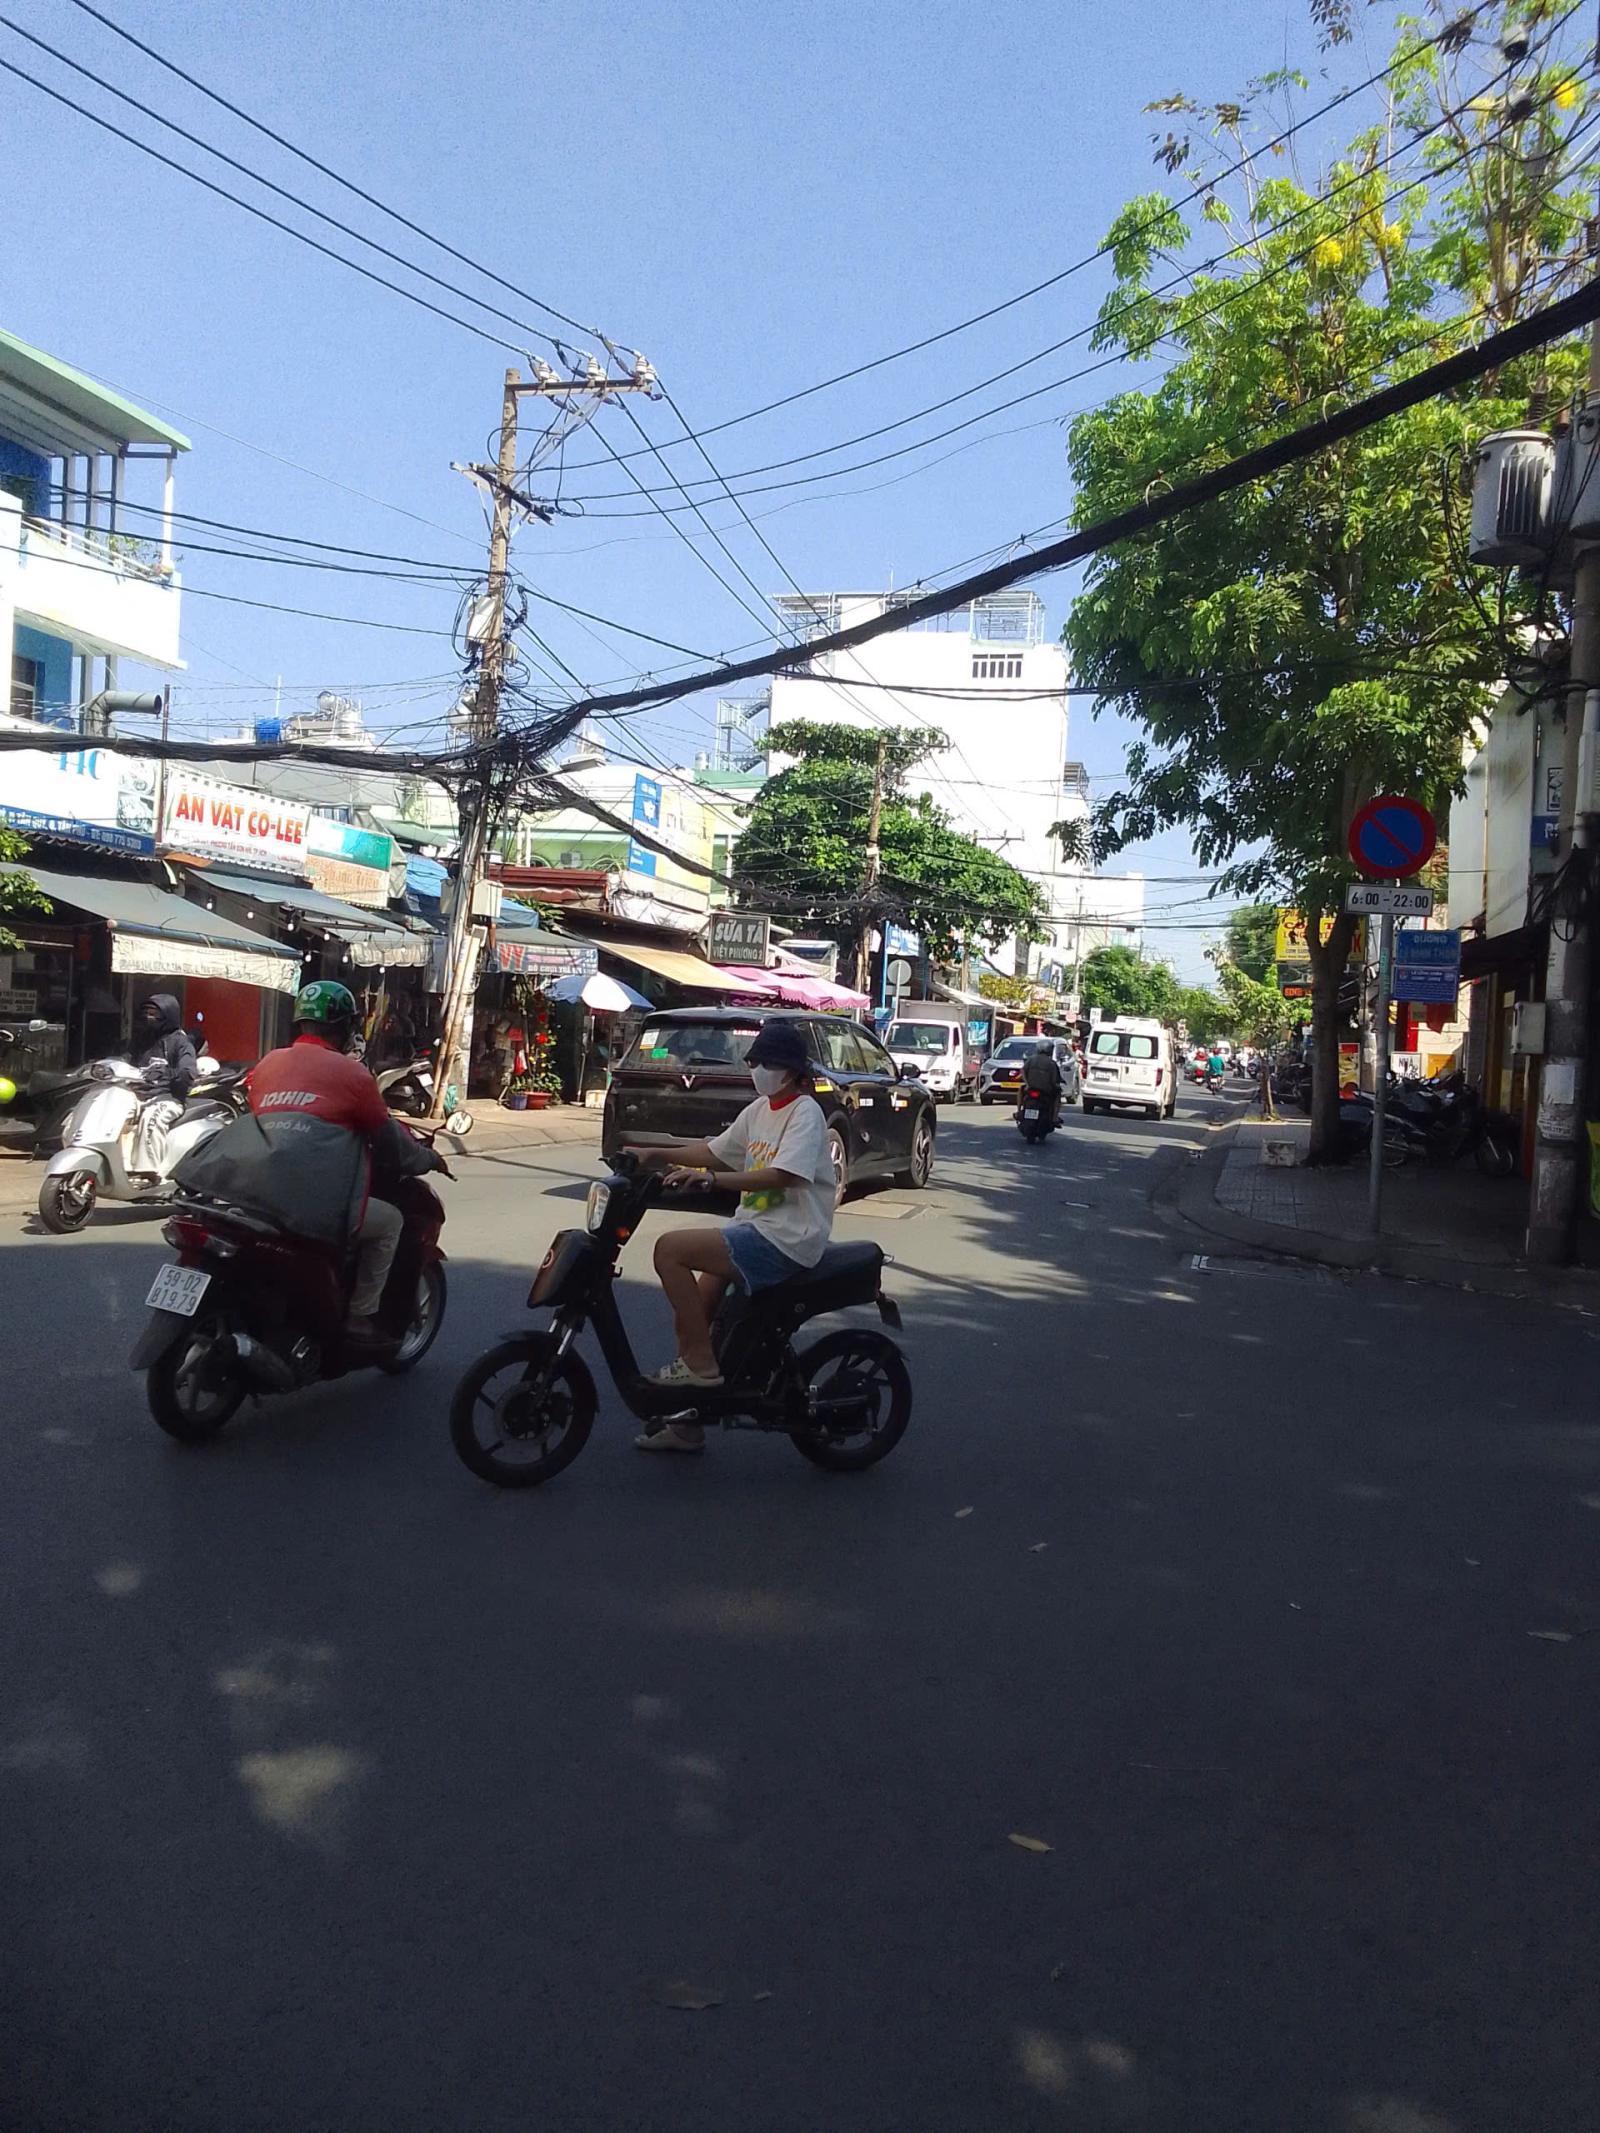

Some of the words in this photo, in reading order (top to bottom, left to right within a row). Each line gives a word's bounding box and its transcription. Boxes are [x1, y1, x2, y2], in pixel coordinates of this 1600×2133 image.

[248, 810, 304, 845] CO-LEE
[1352, 891, 1379, 905] 6:00
[1393, 895, 1429, 908] 22:00
[500, 943, 525, 969] VY
[151, 1287, 198, 1313] 819.79
